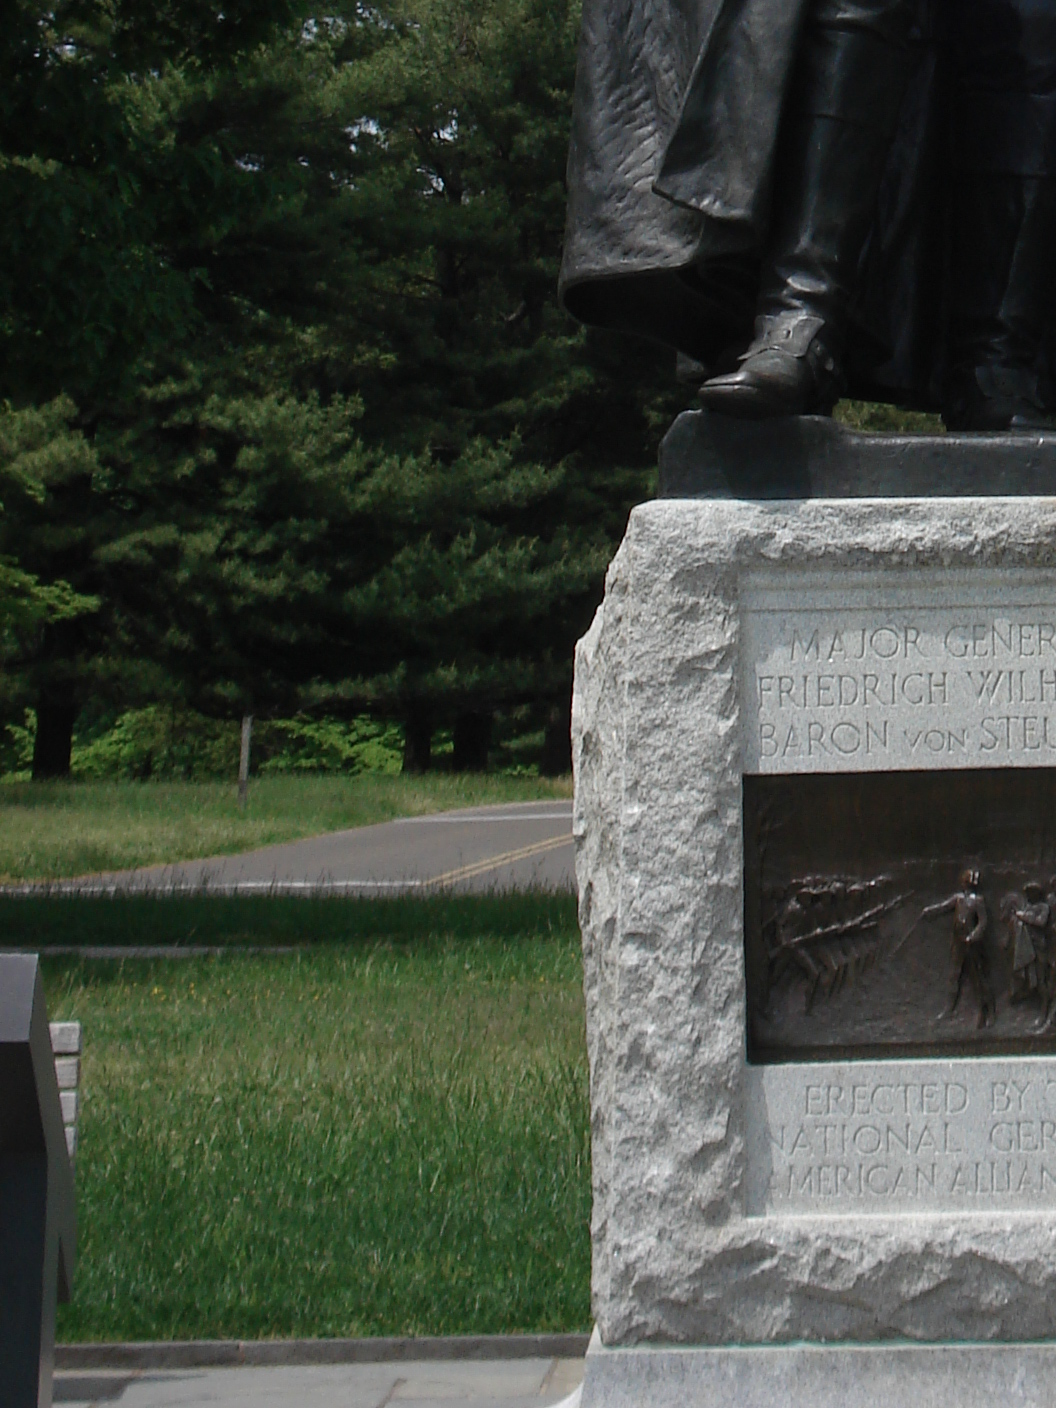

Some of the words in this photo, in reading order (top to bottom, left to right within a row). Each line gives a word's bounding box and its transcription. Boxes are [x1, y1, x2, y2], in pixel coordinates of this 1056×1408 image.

[790, 626, 925, 662] MAJOR
[758, 671, 948, 709] FRIEDRICH
[760, 720, 889, 758] BARON
[805, 1082, 968, 1117] ERECTED
[991, 1080, 1031, 1114] BY
[766, 1122, 961, 1156] NATIONAL
[763, 1162, 937, 1198] AMERICAN
